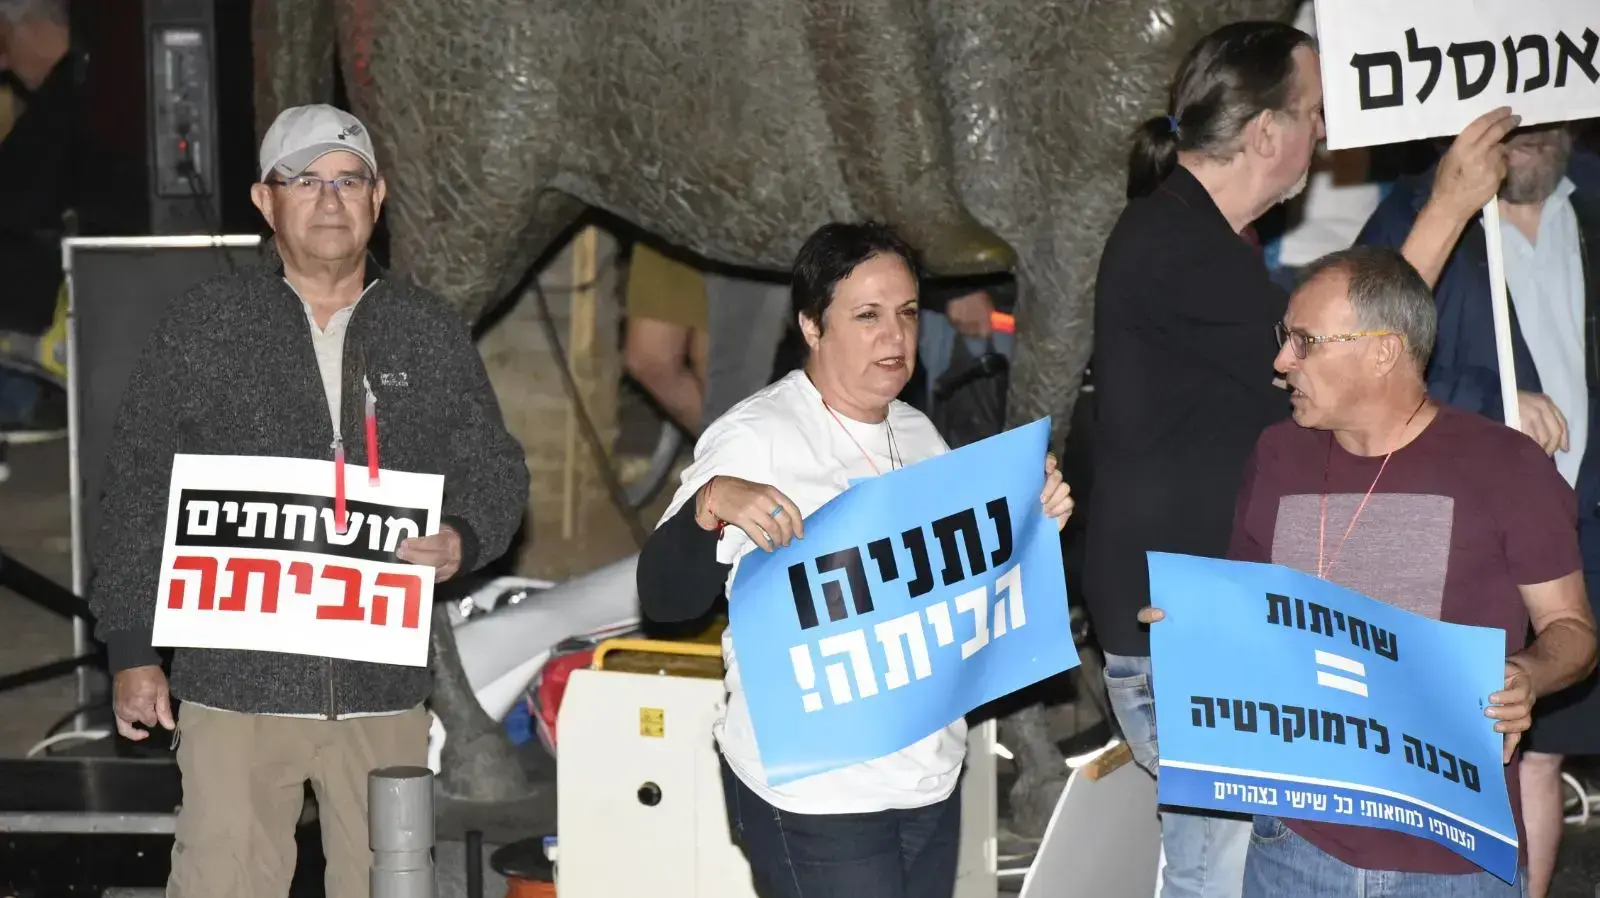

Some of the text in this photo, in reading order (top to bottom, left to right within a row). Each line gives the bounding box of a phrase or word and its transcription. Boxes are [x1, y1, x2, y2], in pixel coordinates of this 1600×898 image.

[1350, 27, 1600, 110] אמסלם
[185, 500, 420, 552] מושחתים
[788, 496, 1013, 630] נתניהו
[167, 556, 422, 629] הביתה
[1266, 593, 1399, 662] שחיתות
[789, 563, 1026, 713] הביתה!
[1190, 695, 1481, 793] סכנה לדמוקרטיה
[1213, 781, 1475, 852] הצטרפו למחאות! כל שישי בצהריים
